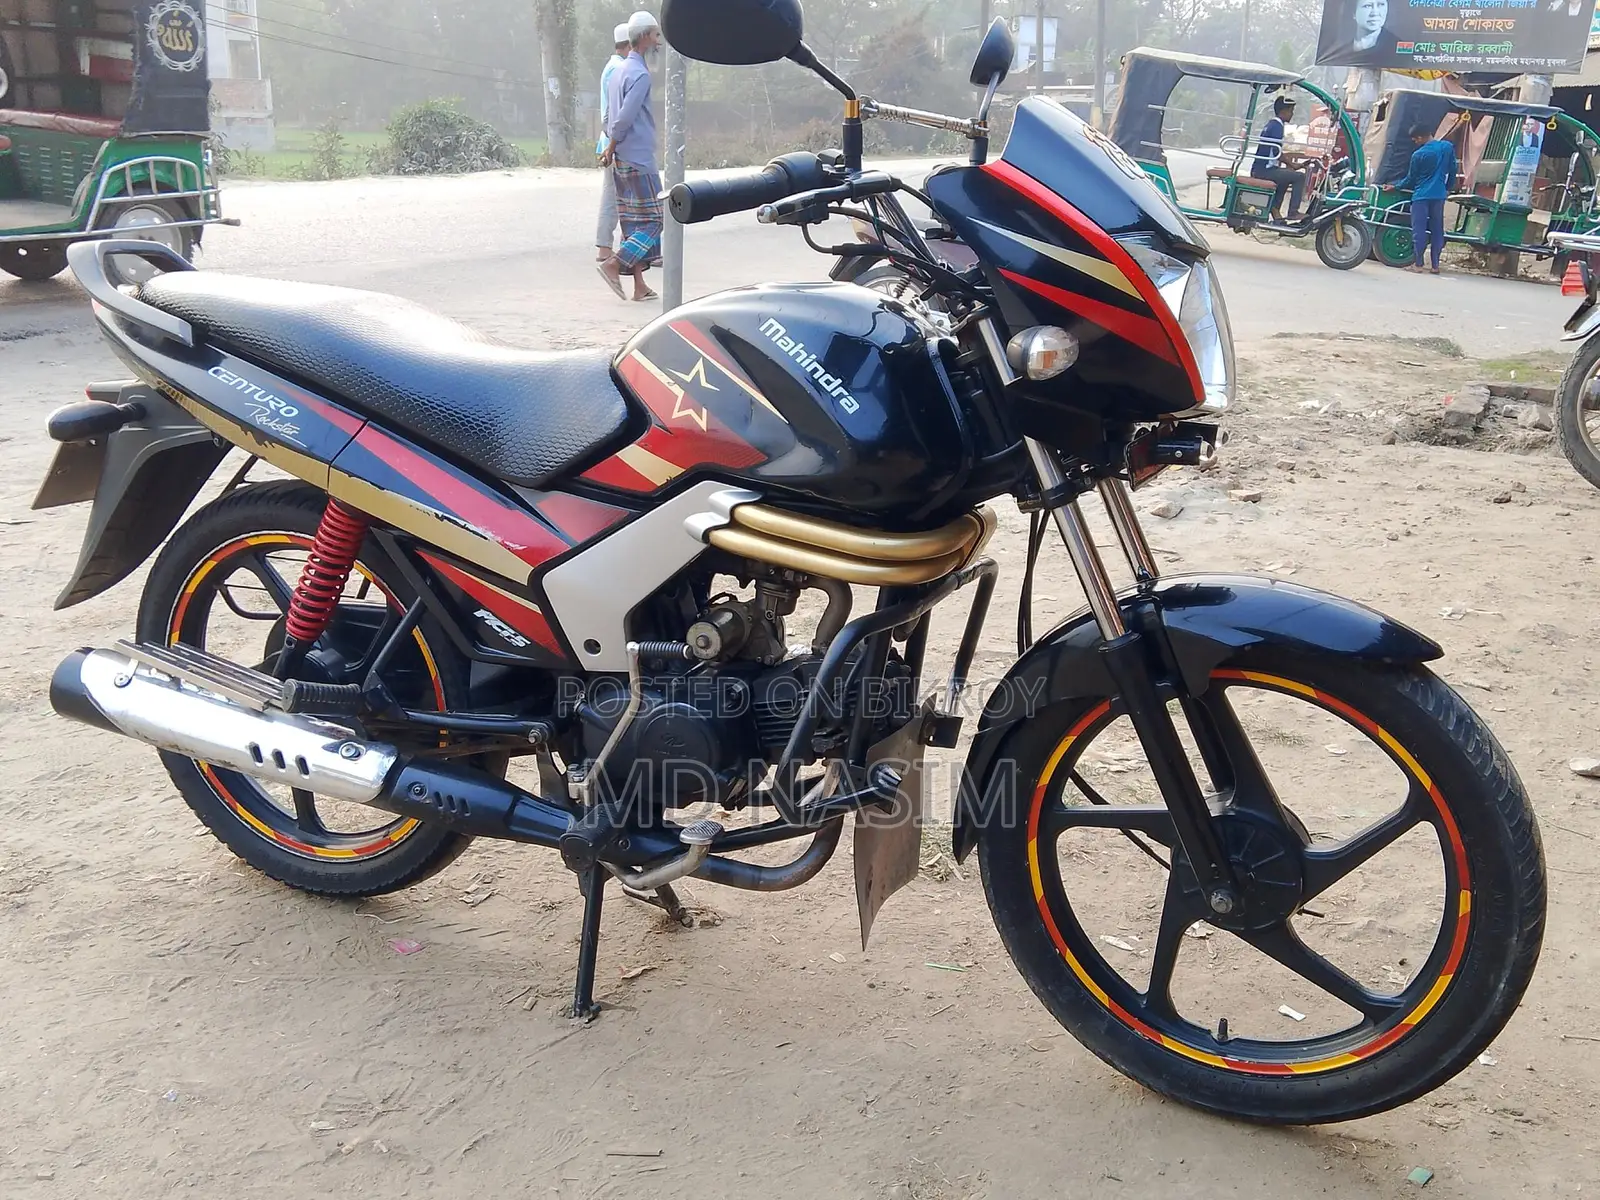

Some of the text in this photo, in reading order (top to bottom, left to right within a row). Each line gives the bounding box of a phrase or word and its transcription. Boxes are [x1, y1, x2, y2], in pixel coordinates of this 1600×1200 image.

[1423, 17, 1516, 32] আমরা শোকাহত
[1414, 42, 1437, 53] মোঃ
[1439, 40, 1474, 54] আরিফ
[759, 317, 860, 415] Mahindra
[207, 366, 299, 418] CENTURO
